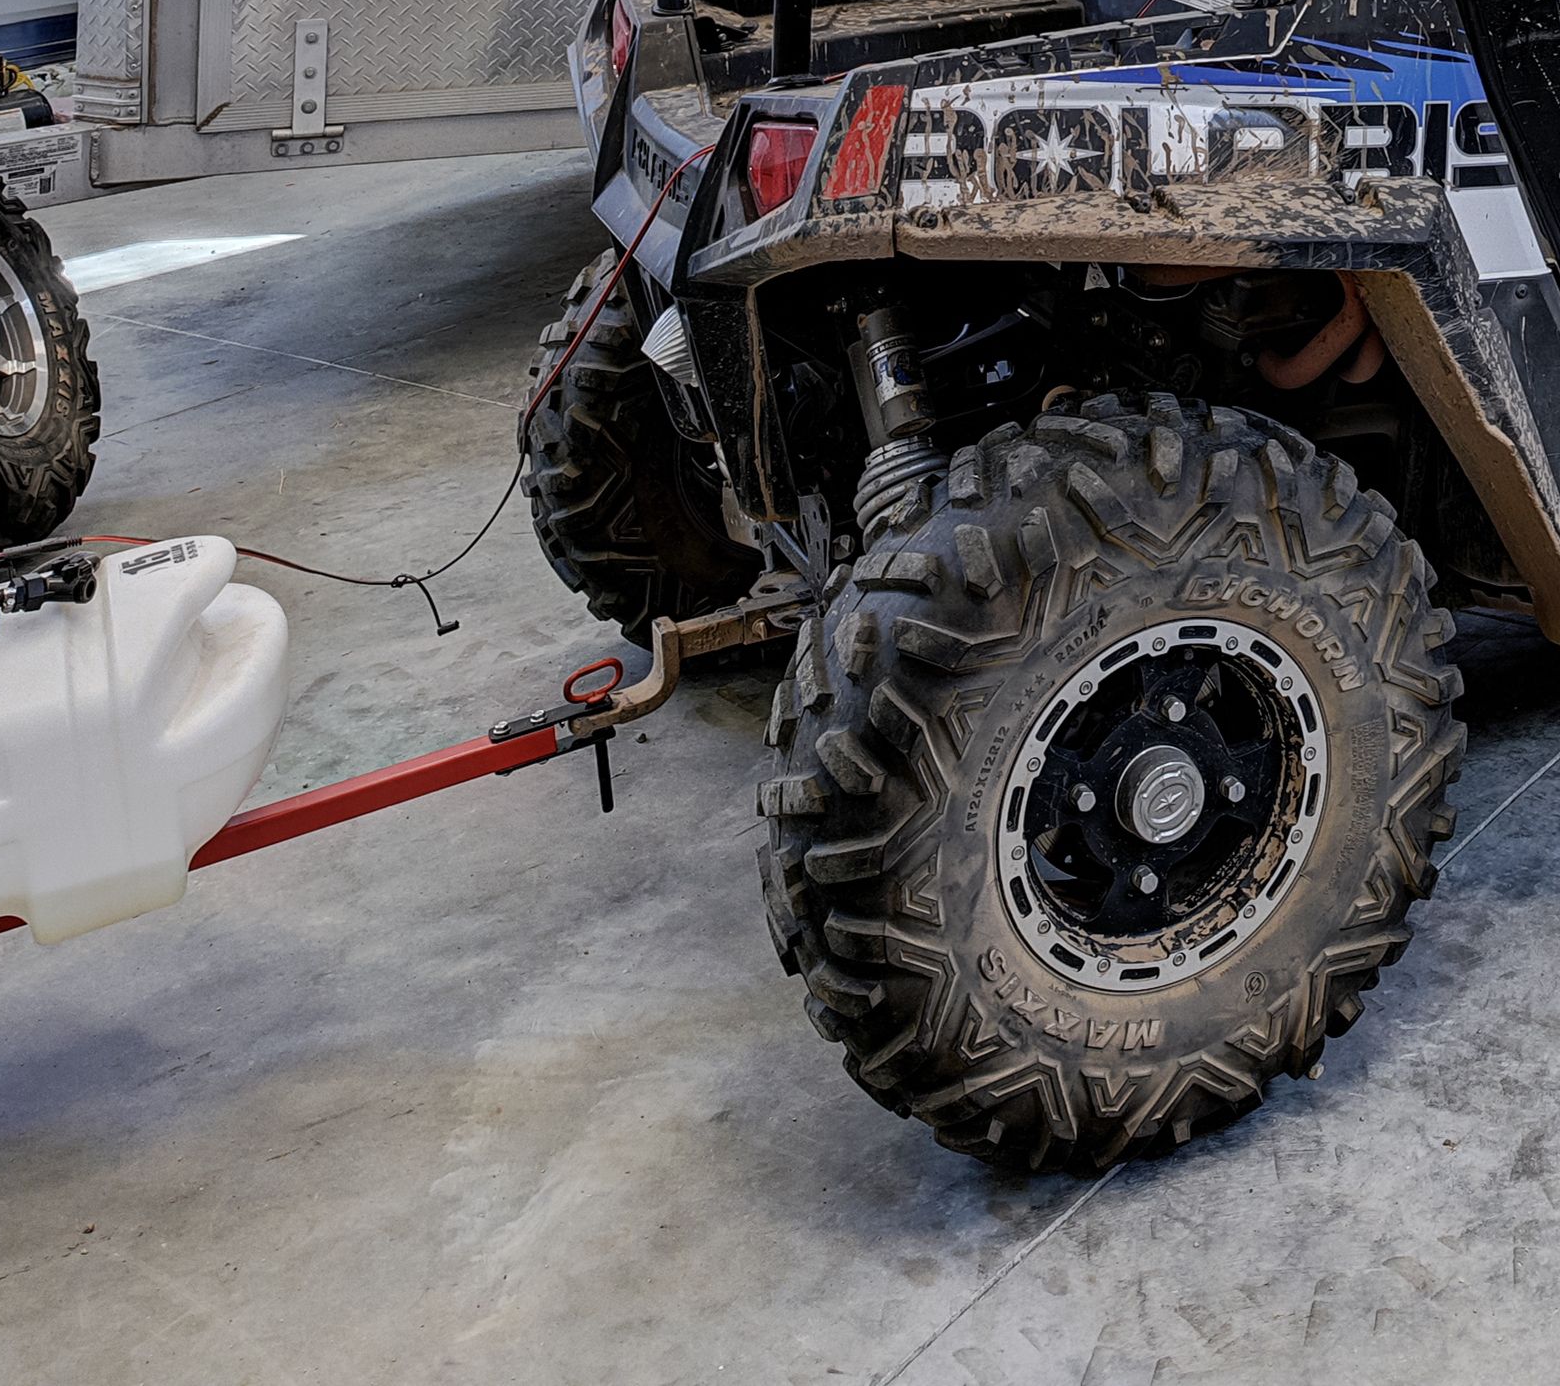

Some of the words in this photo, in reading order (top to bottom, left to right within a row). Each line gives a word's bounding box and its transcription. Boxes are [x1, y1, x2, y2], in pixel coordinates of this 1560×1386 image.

[37, 290, 73, 418] MAXXIS
[121, 550, 171, 575] 15
[978, 947, 1161, 1051] MAXXIS
